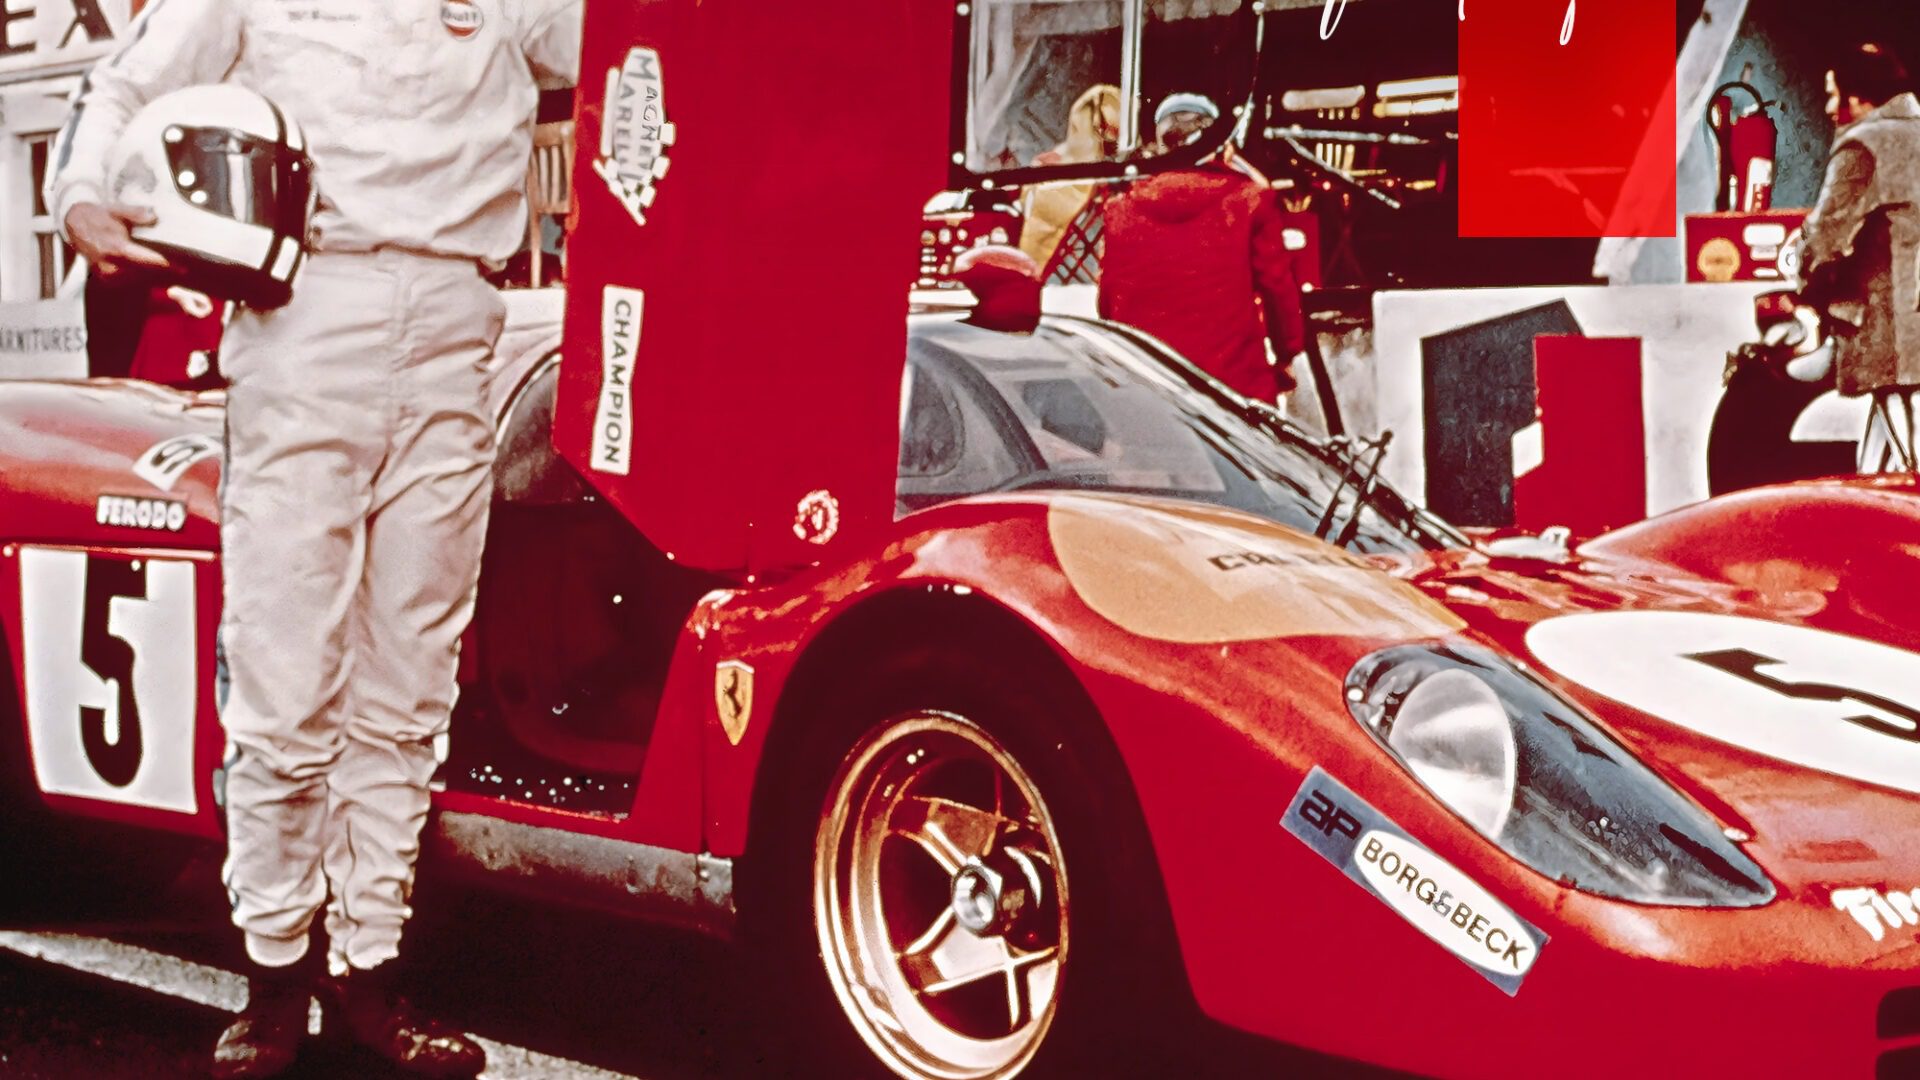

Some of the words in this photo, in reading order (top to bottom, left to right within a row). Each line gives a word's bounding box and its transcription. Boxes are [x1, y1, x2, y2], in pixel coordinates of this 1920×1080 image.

[604, 299, 632, 463] CHAMPION
[96, 494, 186, 532] FERODO
[79, 556, 148, 788] 5
[1675, 647, 1920, 744] 5
[1361, 836, 1528, 970] BORG&BECK
[1830, 886, 1920, 942] Fir
